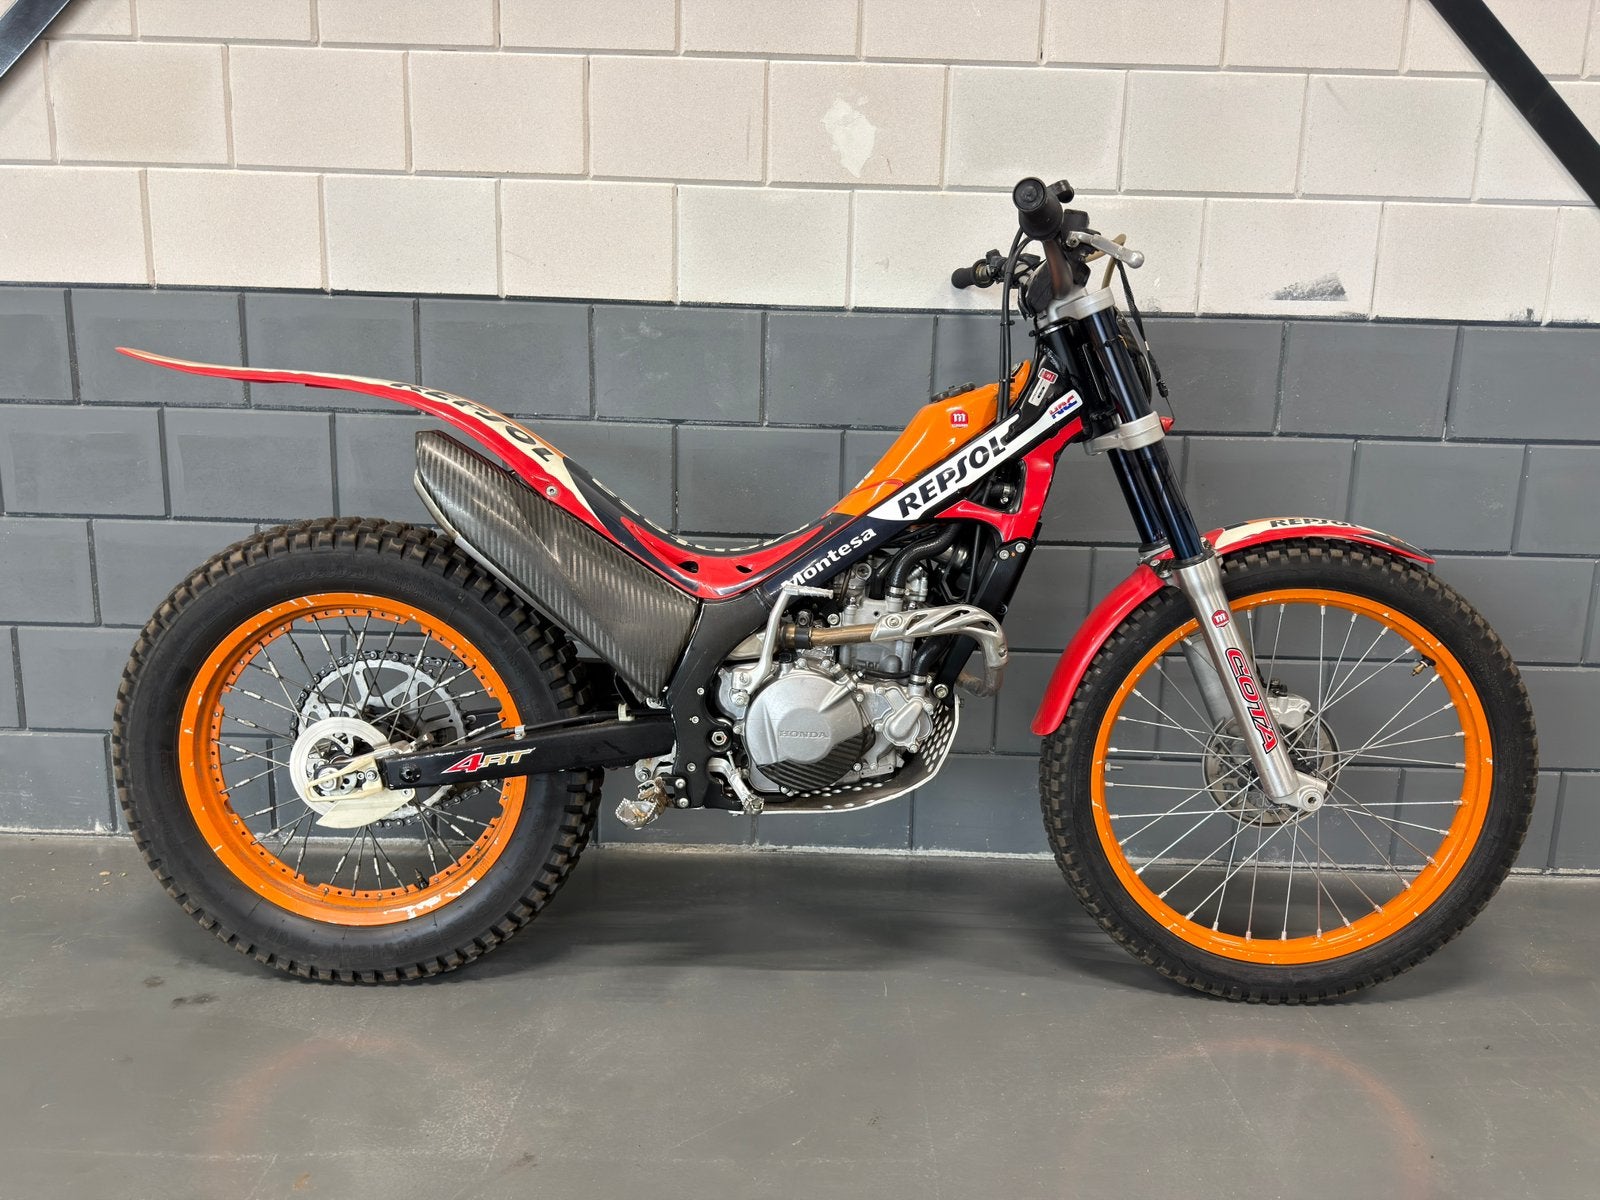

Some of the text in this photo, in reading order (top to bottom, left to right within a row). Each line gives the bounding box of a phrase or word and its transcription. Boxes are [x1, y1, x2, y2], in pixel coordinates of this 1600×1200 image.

[1049, 395, 1077, 419] HRC
[897, 436, 1006, 518] REPSOL
[781, 528, 877, 588] Montesa
[1225, 647, 1278, 754] COTA
[779, 730, 829, 738] HONDA
[440, 747, 536, 774] 4RT
